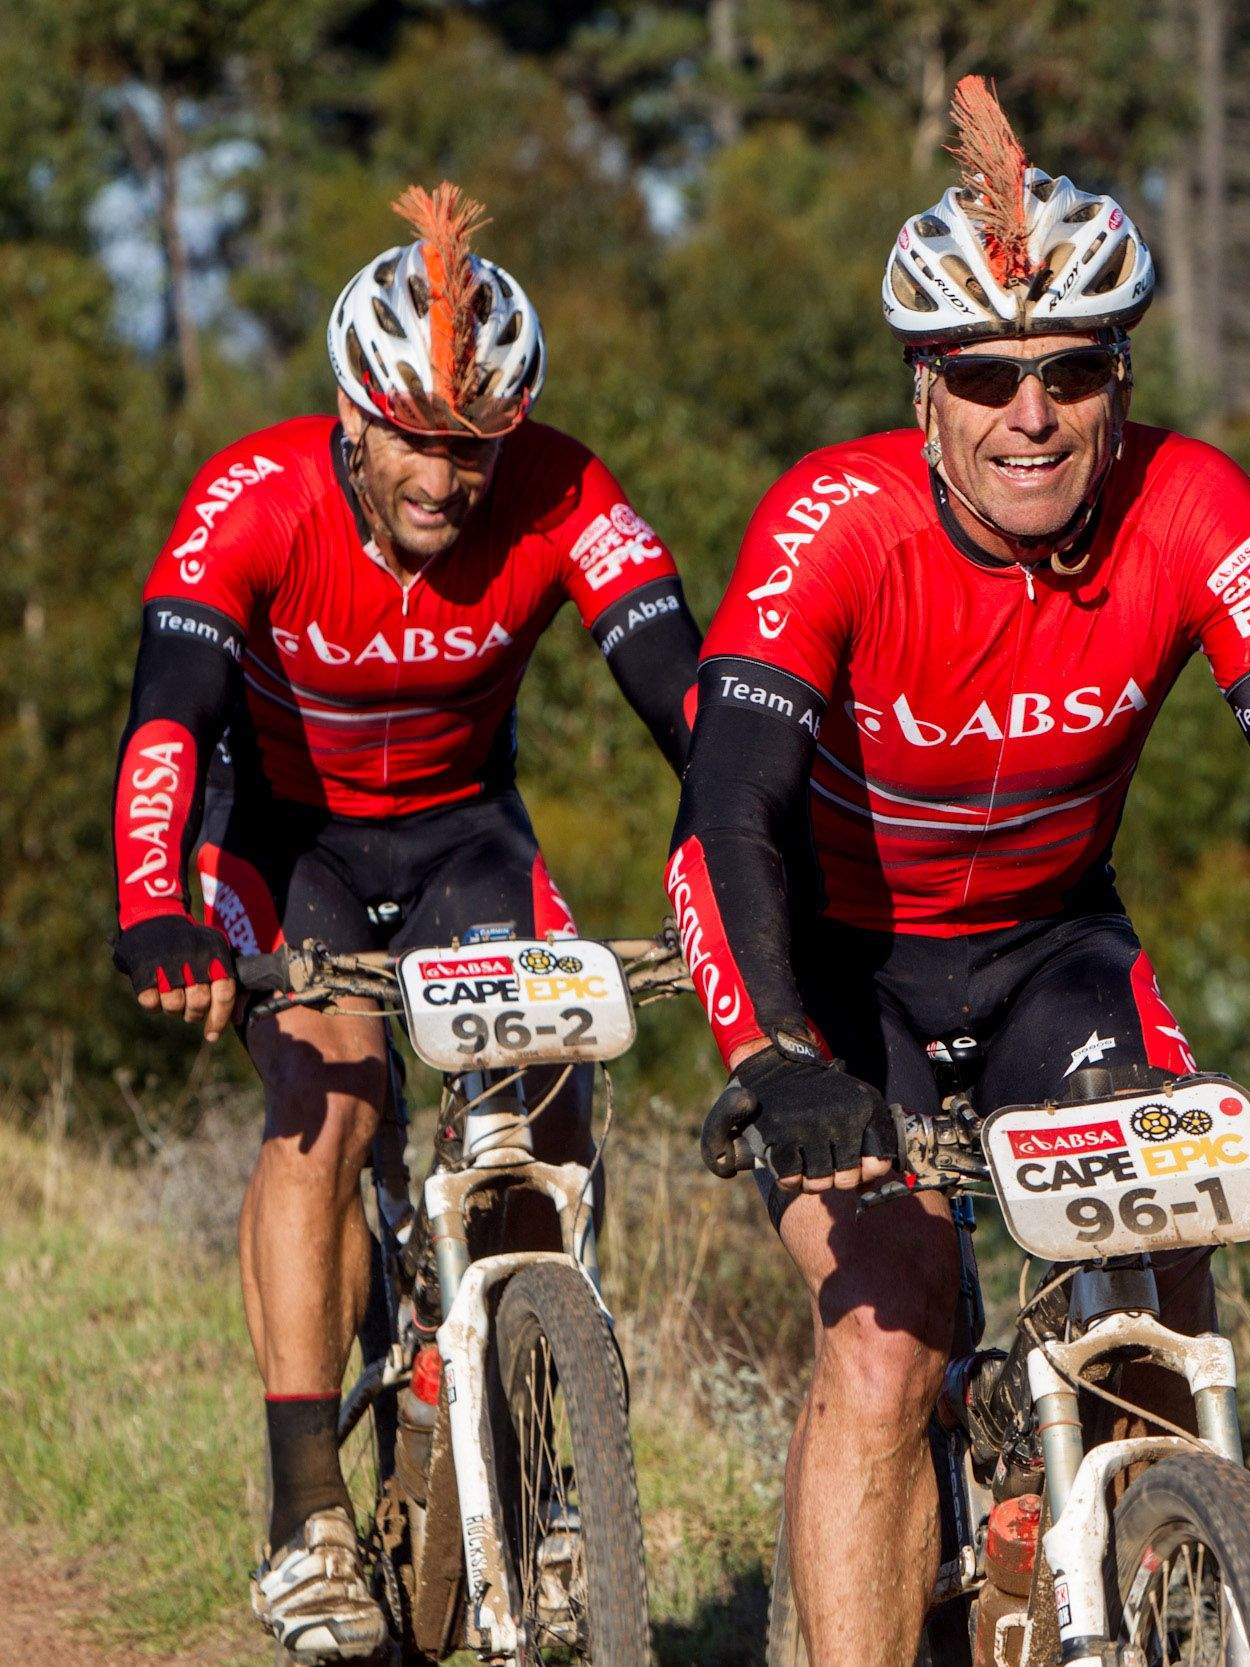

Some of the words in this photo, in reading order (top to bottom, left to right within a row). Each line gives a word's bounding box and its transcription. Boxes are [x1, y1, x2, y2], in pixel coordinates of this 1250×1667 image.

[934, 278, 975, 316] RUDY
[1049, 261, 1081, 313] RUDY
[195, 454, 285, 528] ABSA
[773, 472, 881, 567] ABSA
[157, 611, 219, 642] Team
[628, 595, 680, 630] Absa
[354, 621, 512, 667] ABSA
[720, 676, 793, 717] Team
[949, 677, 1148, 746] ABSA
[130, 742, 184, 849] ABSA
[423, 978, 520, 1006] CAPE
[525, 975, 609, 1000] EPIC
[452, 961, 508, 977] ABSA
[452, 1007, 597, 1055] 96-2
[1051, 1128, 1118, 1150] ABSA
[1016, 1151, 1138, 1193] CAPE
[1140, 1133, 1250, 1176] EPIC
[1065, 1177, 1234, 1243] 96-1
